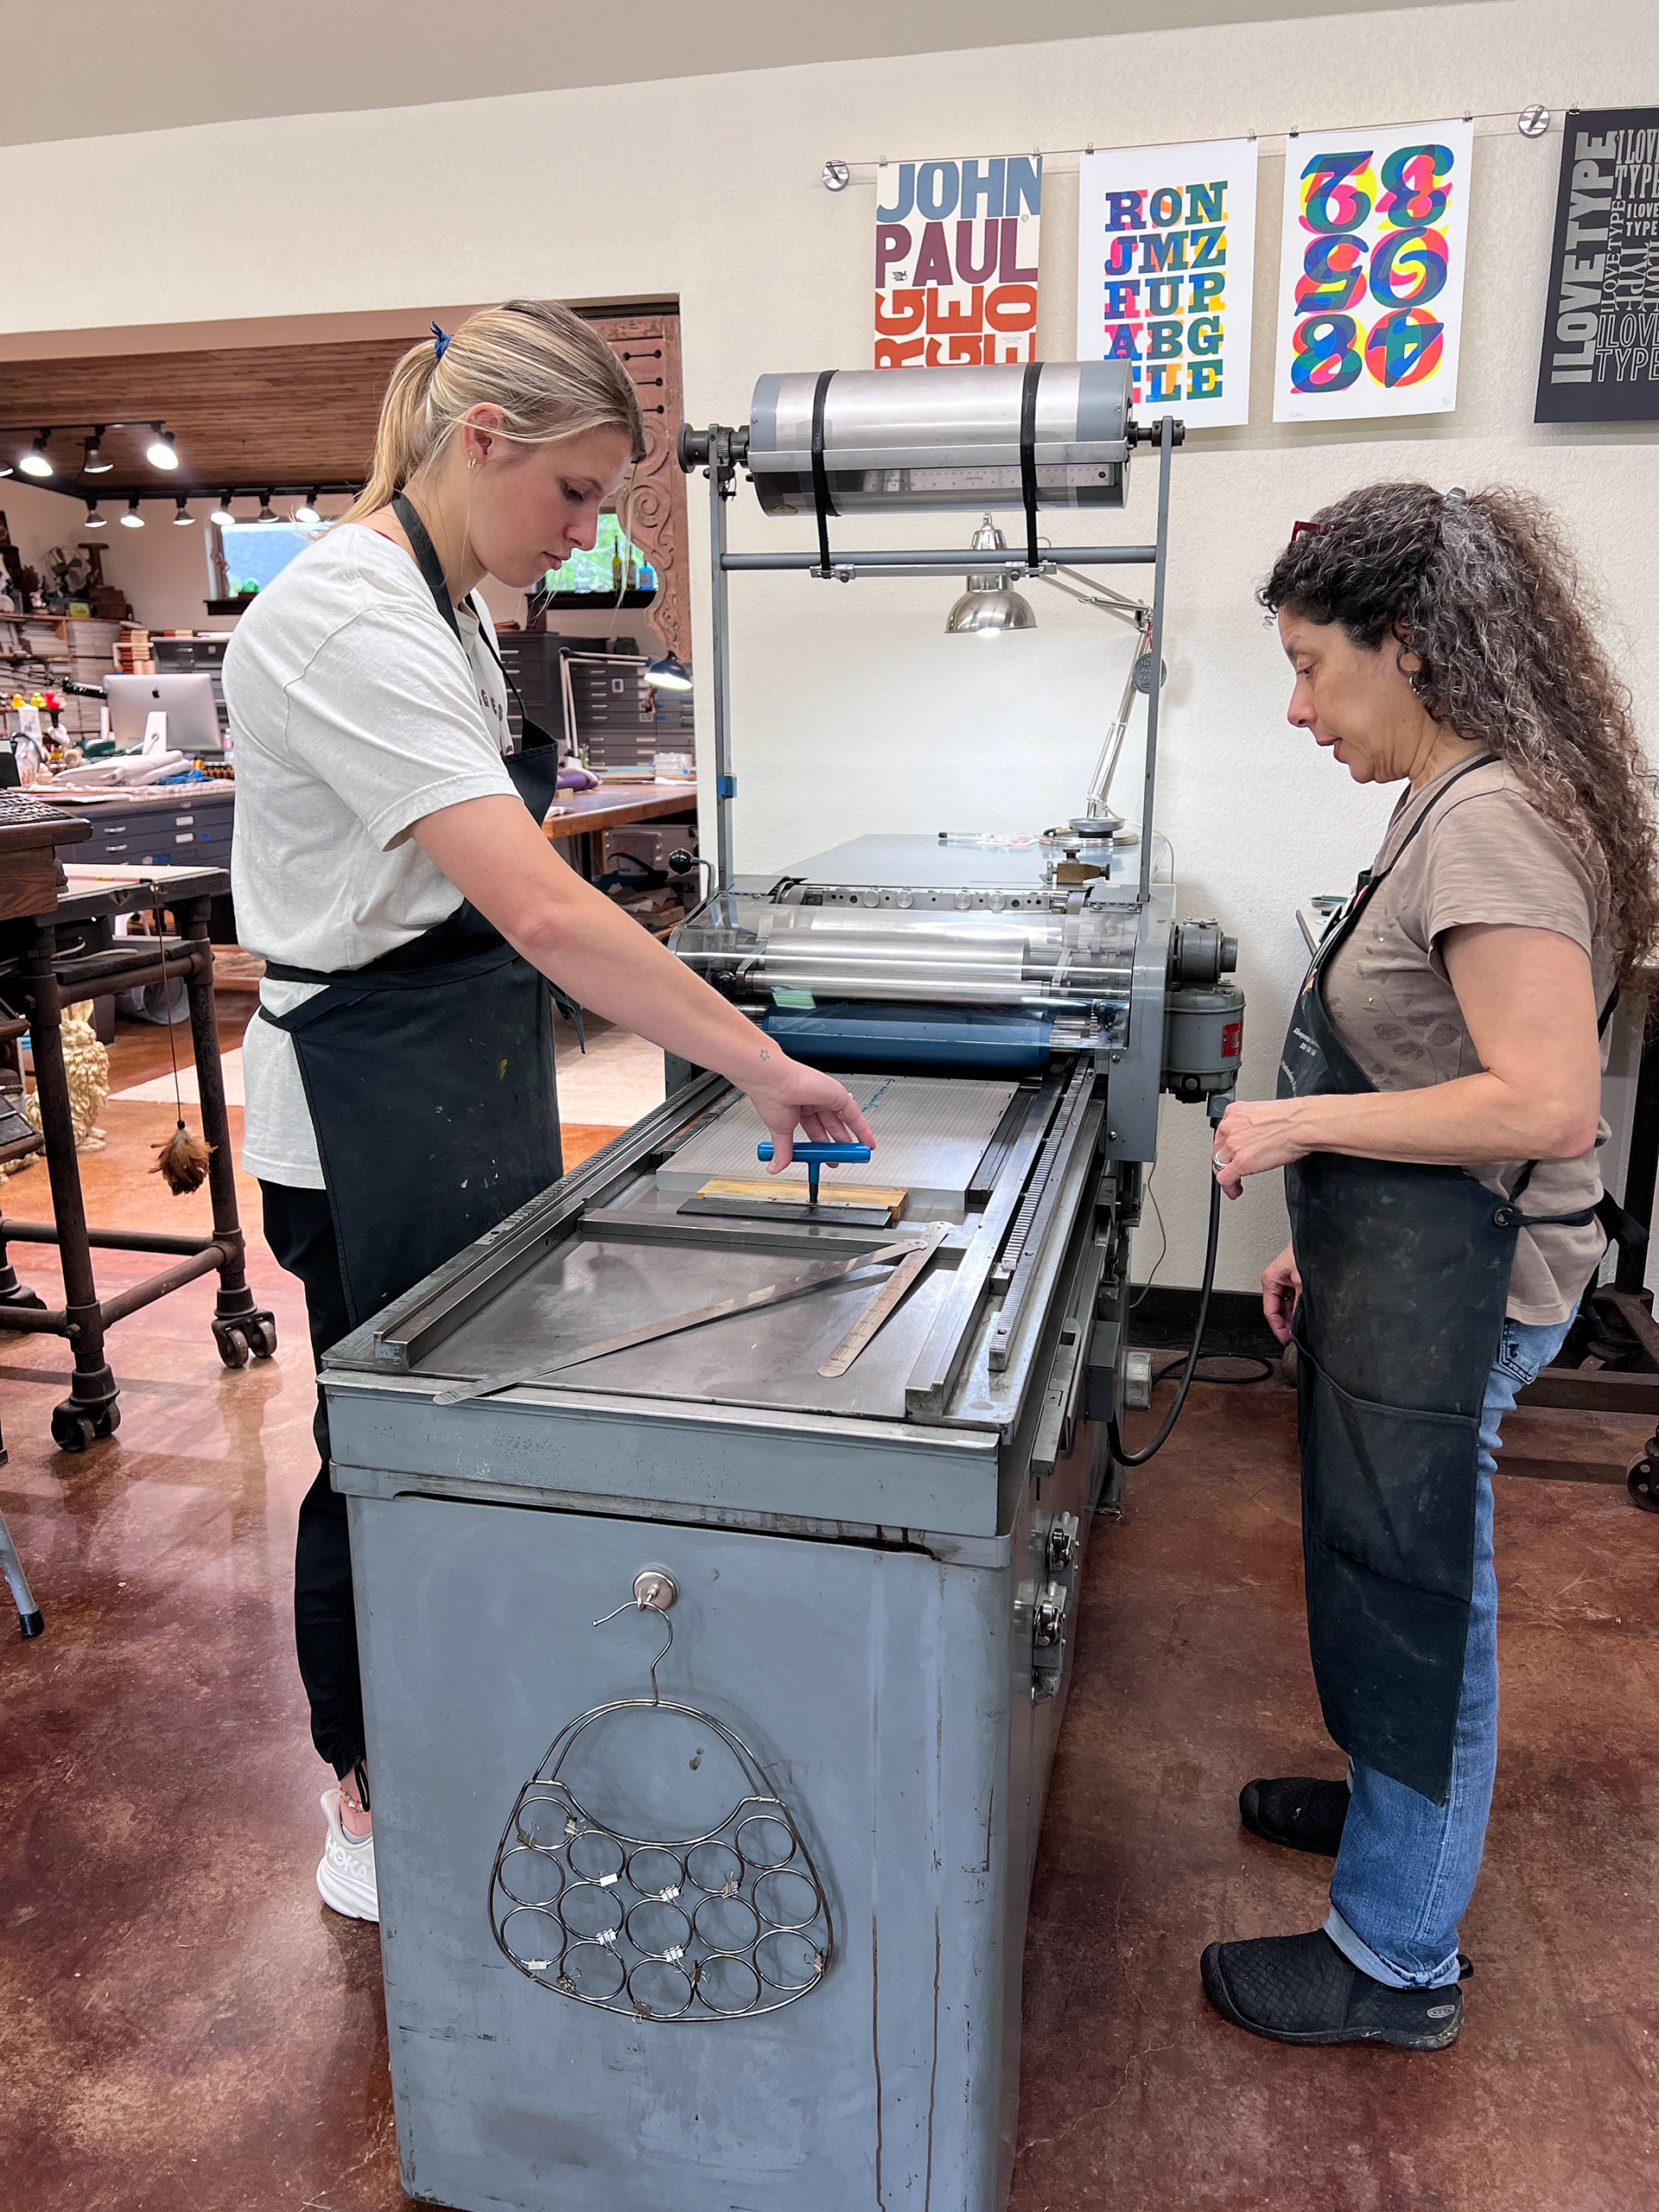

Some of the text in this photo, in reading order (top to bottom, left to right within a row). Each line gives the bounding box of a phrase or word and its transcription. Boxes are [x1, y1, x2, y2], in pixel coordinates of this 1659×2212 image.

[876, 156, 1043, 223] JOHN
[1565, 131, 1618, 251] TYPE
[875, 218, 1039, 289] PAUL
[1607, 200, 1626, 251] TYPE
[1625, 220, 1658, 237] TYPE
[1601, 253, 1621, 305] LOVE
[1615, 243, 1649, 311] TYPE
[1553, 253, 1606, 366] LOVE
[1595, 347, 1659, 383] TYPE
[326, 1834, 368, 1883] HOKA
